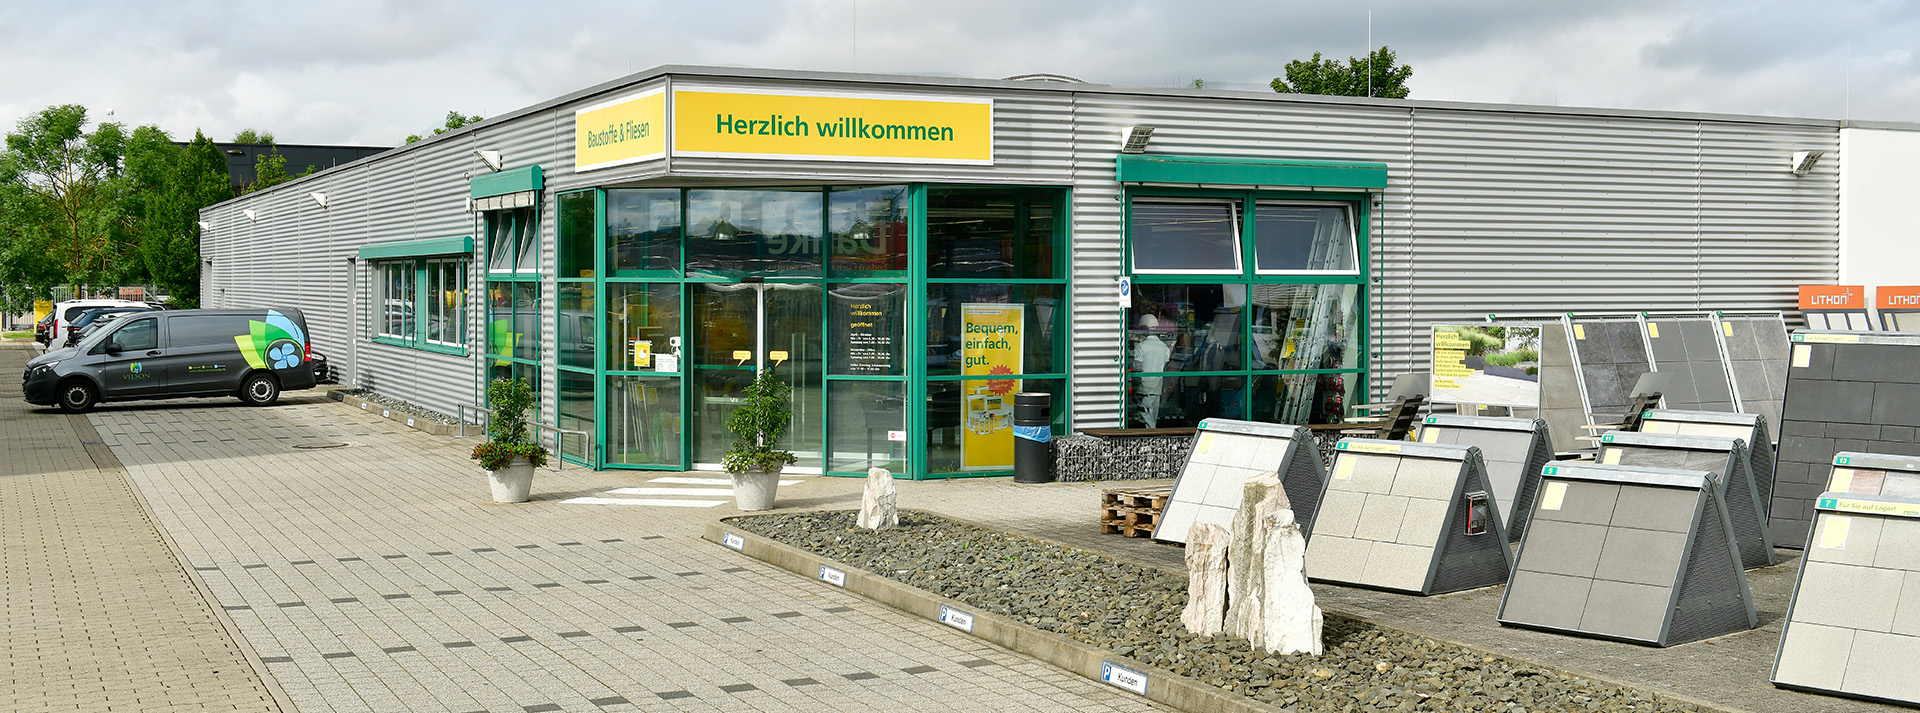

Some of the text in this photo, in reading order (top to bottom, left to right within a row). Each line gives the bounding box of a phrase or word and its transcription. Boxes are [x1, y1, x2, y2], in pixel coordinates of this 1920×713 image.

[588, 120, 650, 148] Baustoffe & Fliesen
[716, 113, 954, 142] Herzlich willkommen
[966, 322, 1018, 336] Bequem,
[966, 337, 1012, 351] einfach,
[966, 355, 990, 368] gut.
[1875, 504, 1896, 512] Lager!
[950, 614, 966, 626] Kunden
[1118, 673, 1138, 686] Kunden
